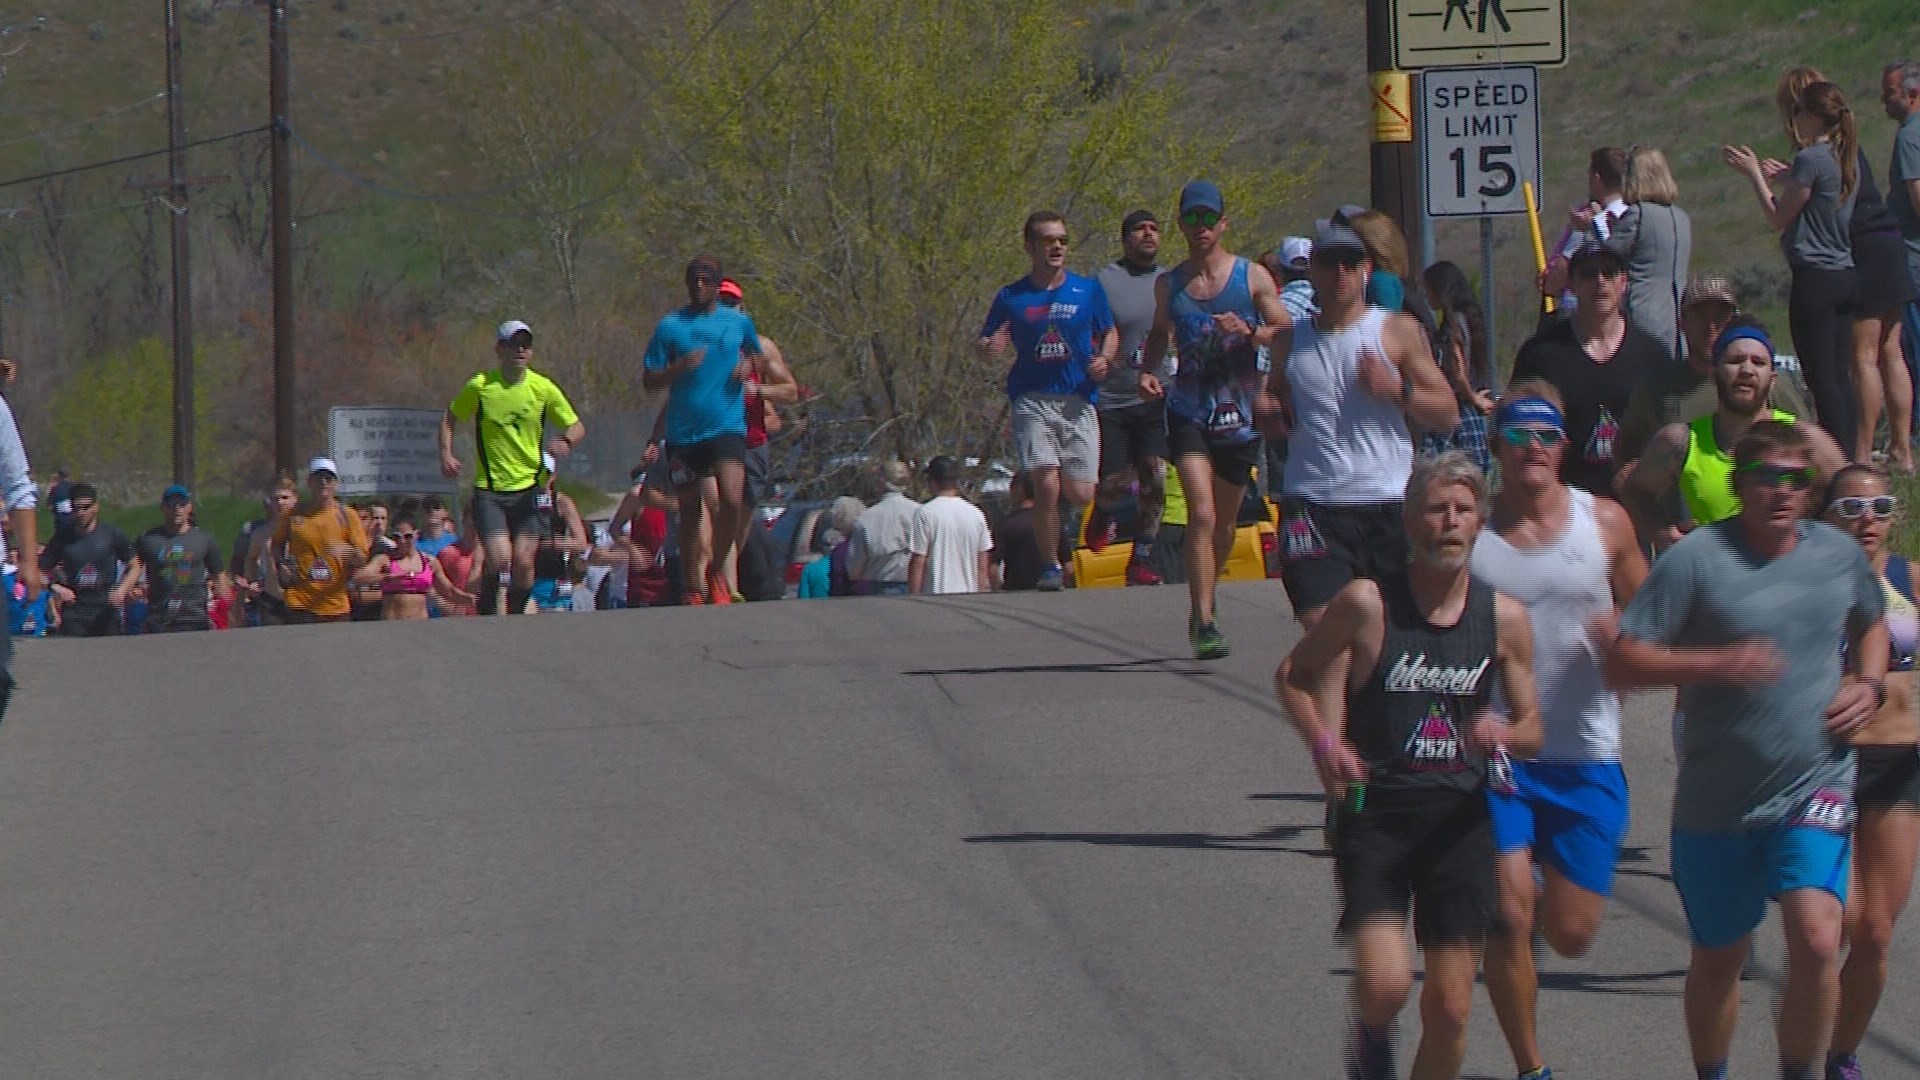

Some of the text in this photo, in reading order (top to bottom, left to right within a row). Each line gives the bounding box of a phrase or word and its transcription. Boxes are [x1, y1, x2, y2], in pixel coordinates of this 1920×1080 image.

[1434, 84, 1528, 108] SPEED
[1445, 114, 1518, 137] LIMIT
[1449, 146, 1516, 198] 15
[1385, 651, 1491, 692] blessed
[1414, 738, 1457, 758] 2526
